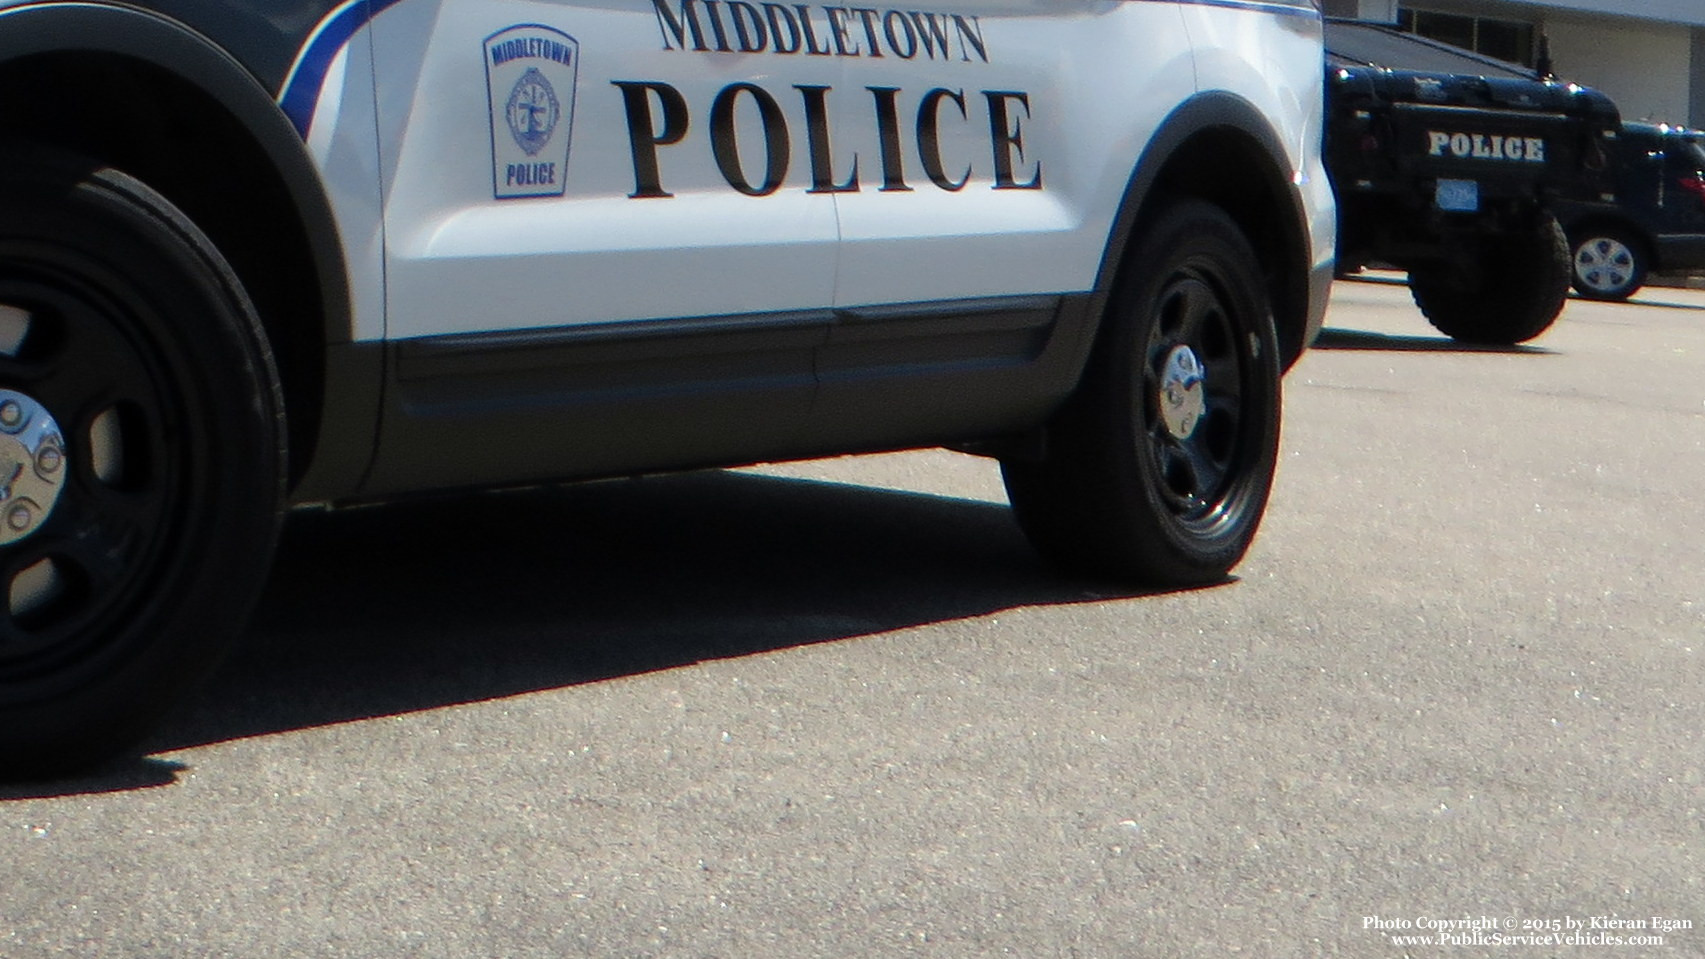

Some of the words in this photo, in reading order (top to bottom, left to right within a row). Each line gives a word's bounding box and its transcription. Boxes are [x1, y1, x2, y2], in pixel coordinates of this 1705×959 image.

[491, 38, 572, 67] MIDDLETOWN
[610, 80, 1043, 199] POLICE
[1428, 131, 1545, 162] POLICE
[506, 162, 556, 186] POLICE
